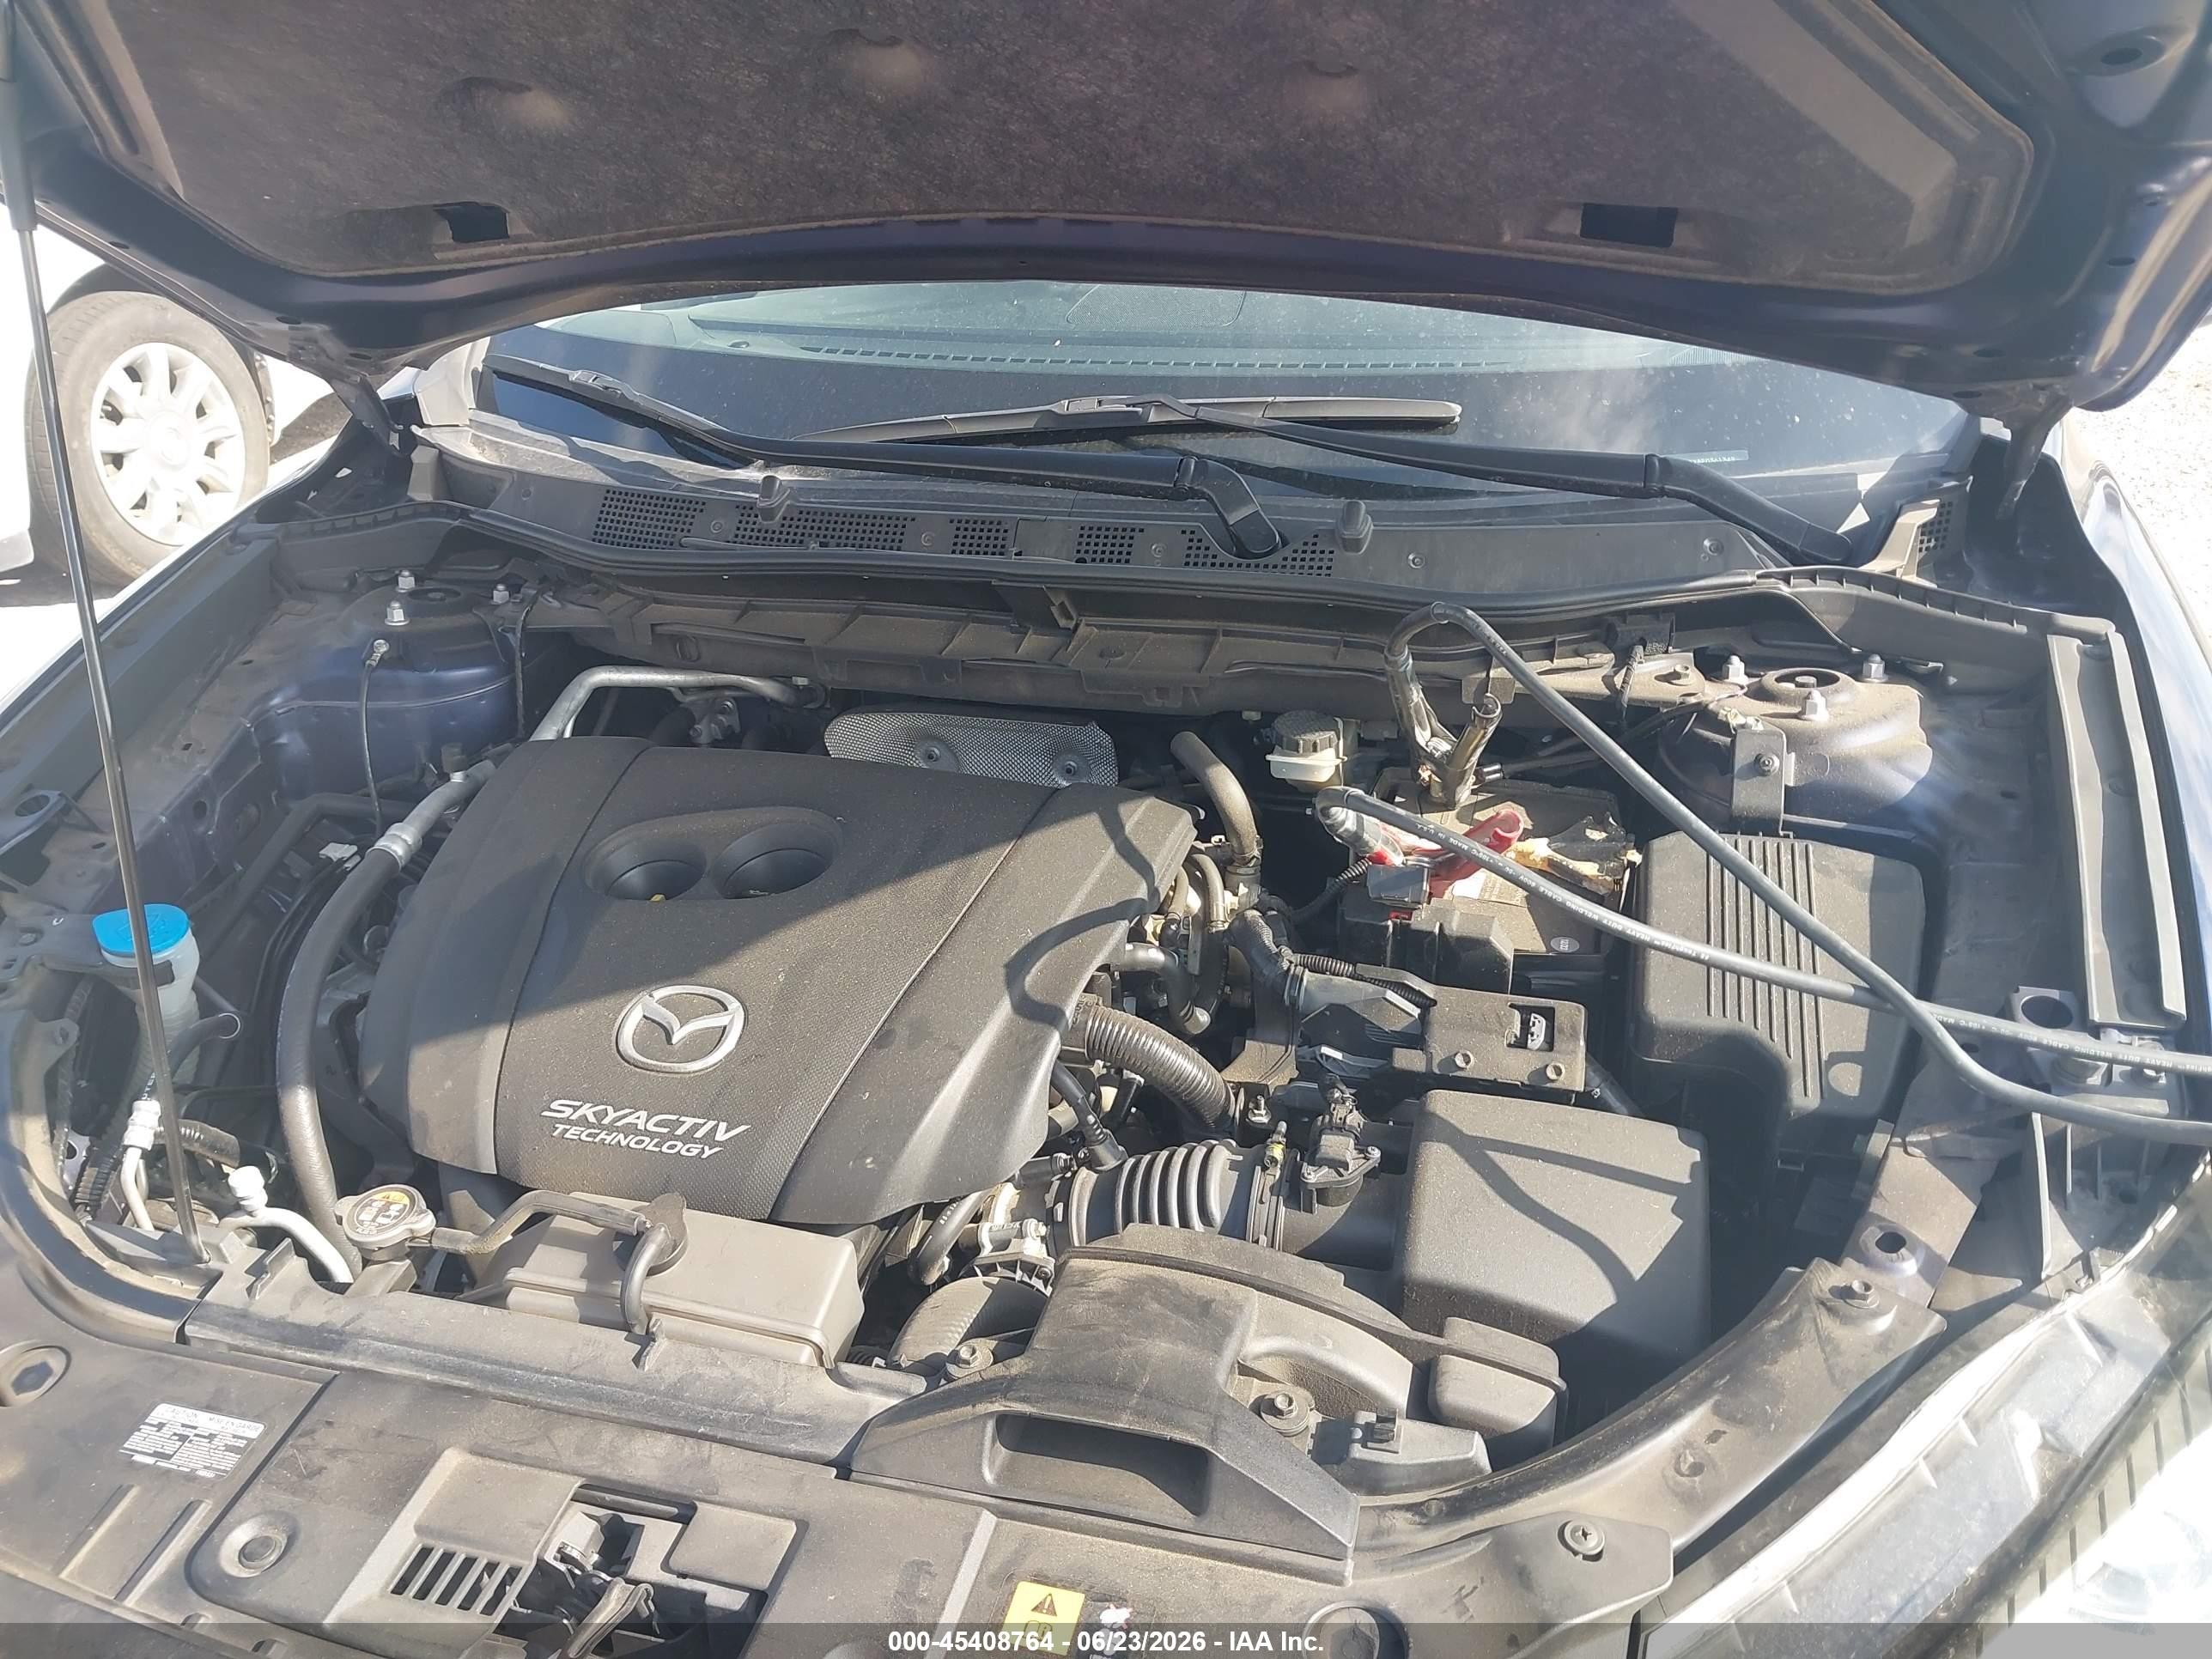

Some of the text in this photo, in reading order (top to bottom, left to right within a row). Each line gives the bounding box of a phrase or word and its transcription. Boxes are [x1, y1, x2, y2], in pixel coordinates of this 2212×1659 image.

[1448, 837, 1468, 851] MADE
[1539, 886, 1562, 902] CABLE
[1565, 902, 1599, 921] WELDING
[2041, 1037, 2069, 1049] CABLE
[2145, 1057, 2172, 1066] HEAVY
[540, 1099, 751, 1142] SKYACTIV
[551, 1124, 723, 1159] TECHNOLOGY
